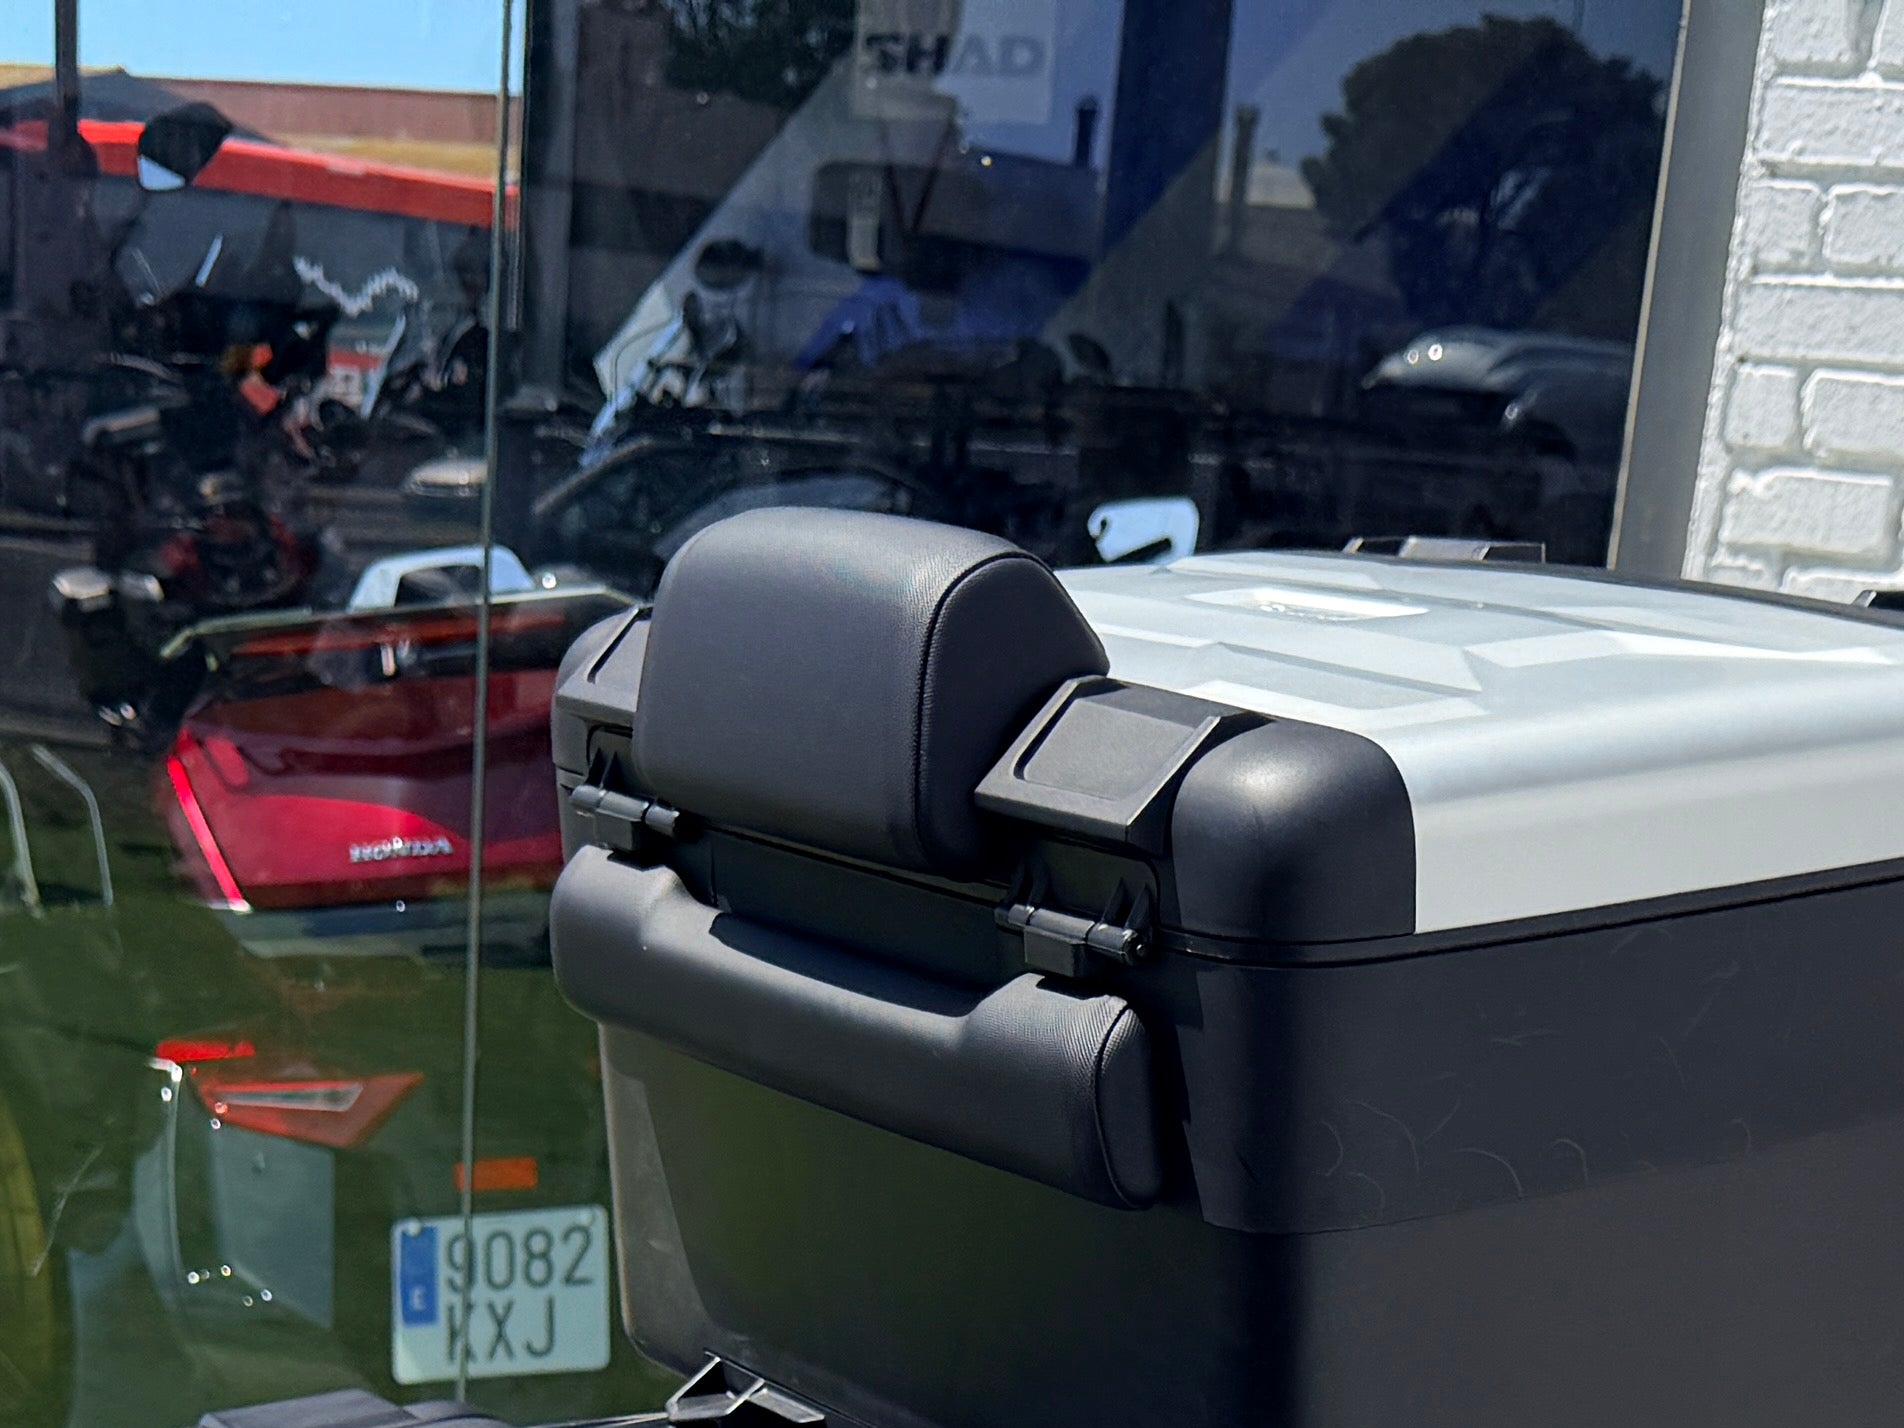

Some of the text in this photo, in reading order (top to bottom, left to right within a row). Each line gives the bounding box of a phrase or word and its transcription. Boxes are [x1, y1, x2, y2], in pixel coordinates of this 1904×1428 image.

[864, 31, 1046, 78] SHAD
[446, 1223, 595, 1297] 9082
[446, 1294, 556, 1364] KXJ
